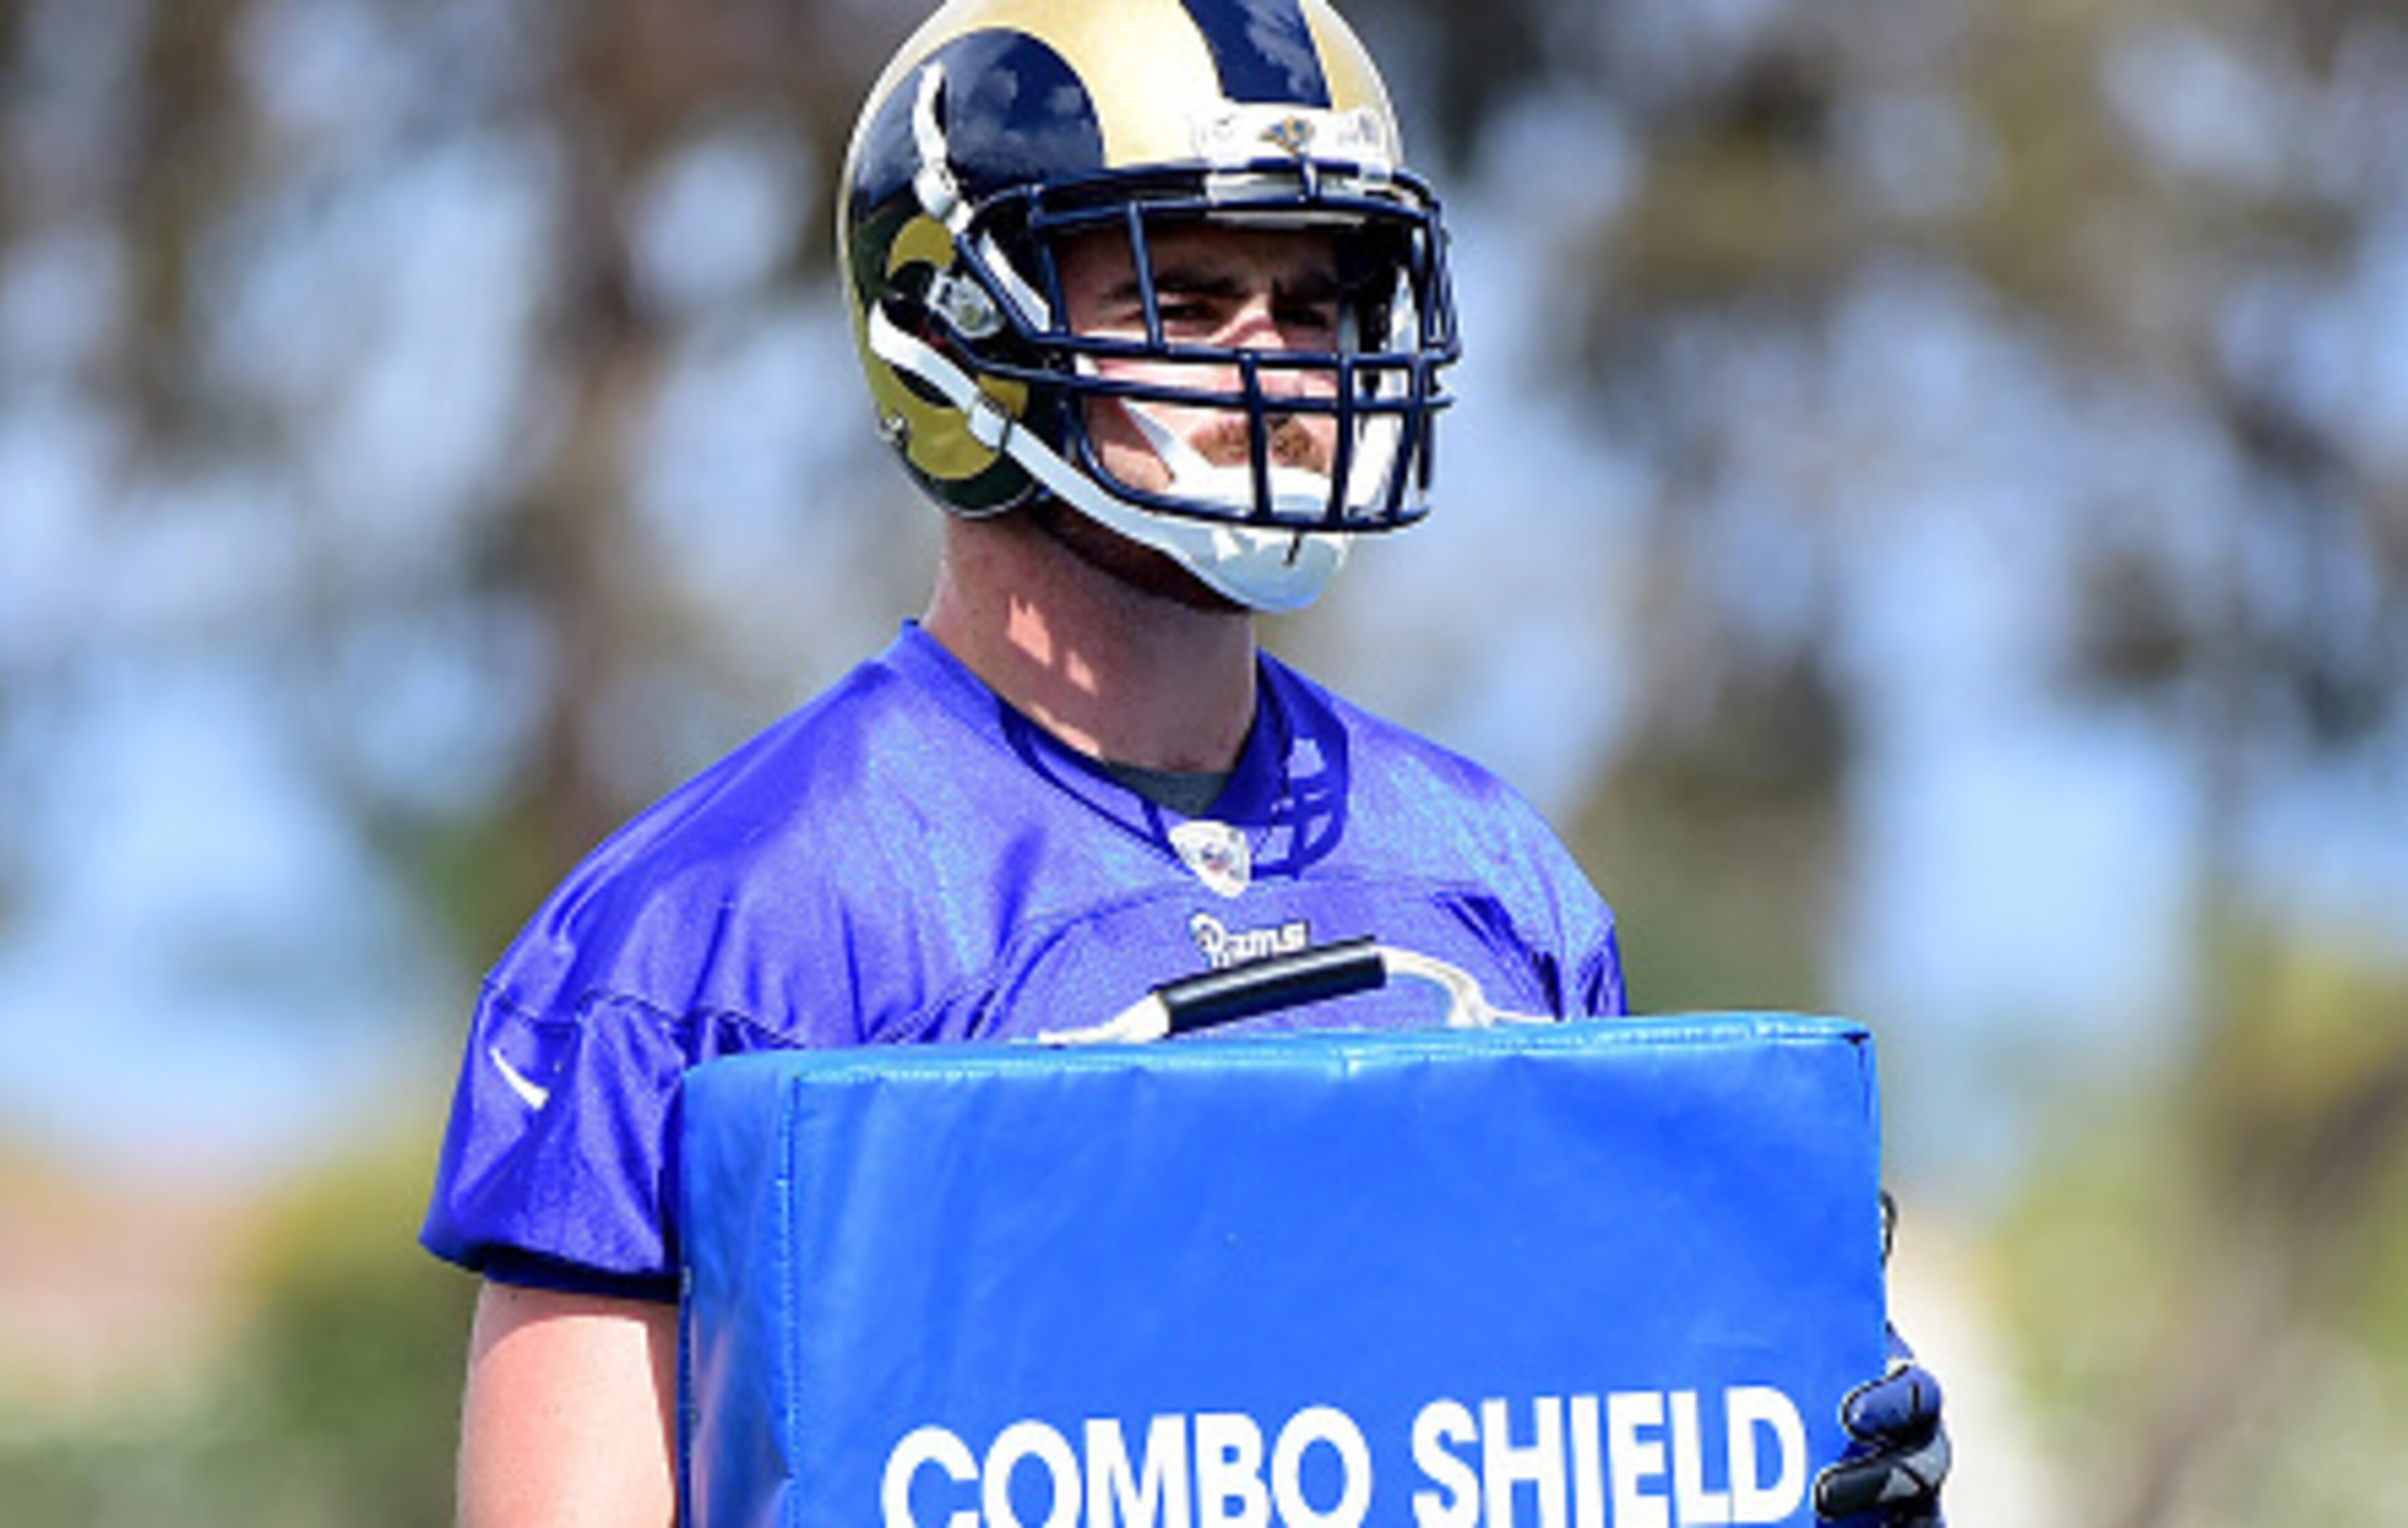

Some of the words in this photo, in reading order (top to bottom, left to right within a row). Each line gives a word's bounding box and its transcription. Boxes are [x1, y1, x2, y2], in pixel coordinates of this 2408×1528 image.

[1189, 912, 1307, 968] Rams
[880, 1406, 1371, 1528] COMBO
[1411, 1386, 1807, 1528] SHIELD
